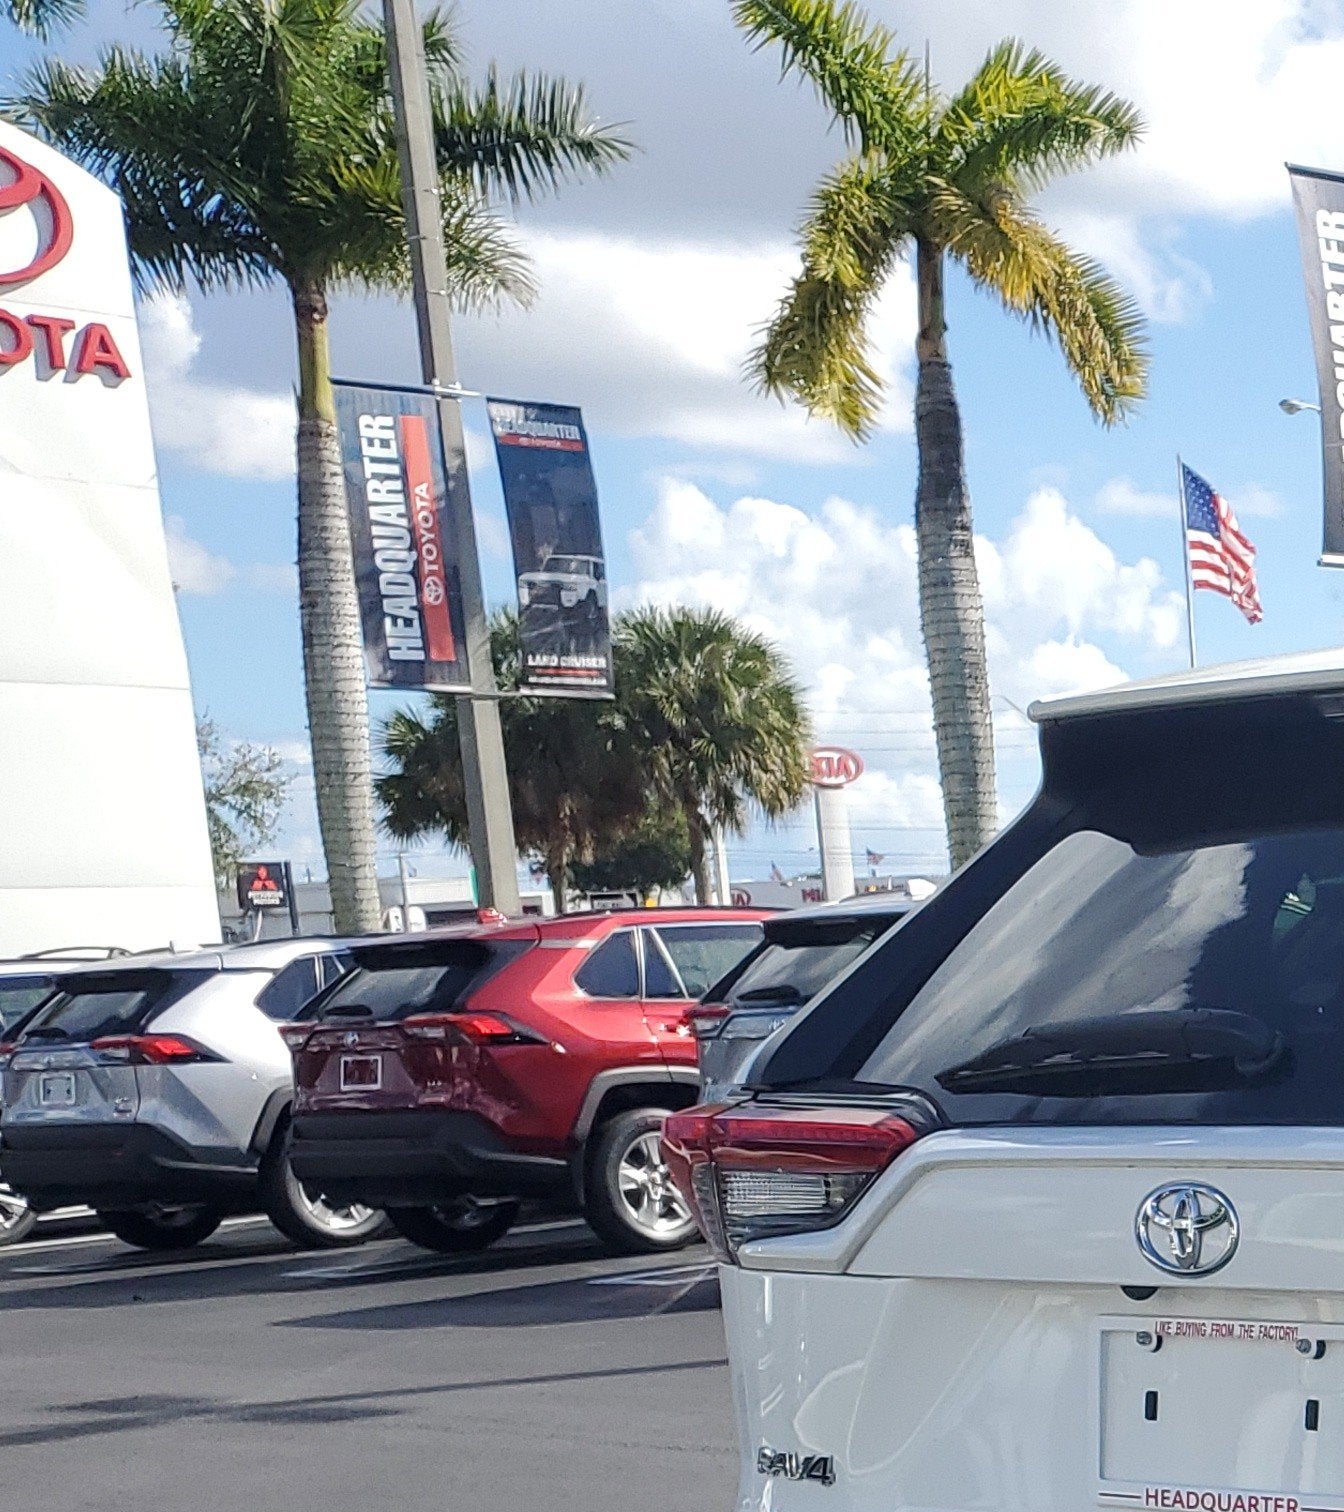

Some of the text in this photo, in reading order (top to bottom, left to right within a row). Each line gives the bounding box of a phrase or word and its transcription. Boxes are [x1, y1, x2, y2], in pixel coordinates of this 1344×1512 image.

[359, 413, 426, 661] HEADQUARTER
[413, 481, 440, 575] TOYOTA
[1154, 1320, 1172, 1335] LIKE
[1174, 1321, 1207, 1338] BUYING
[1209, 1323, 1235, 1338] FROM
[1238, 1324, 1255, 1339] THE
[757, 1446, 836, 1487] RAV4
